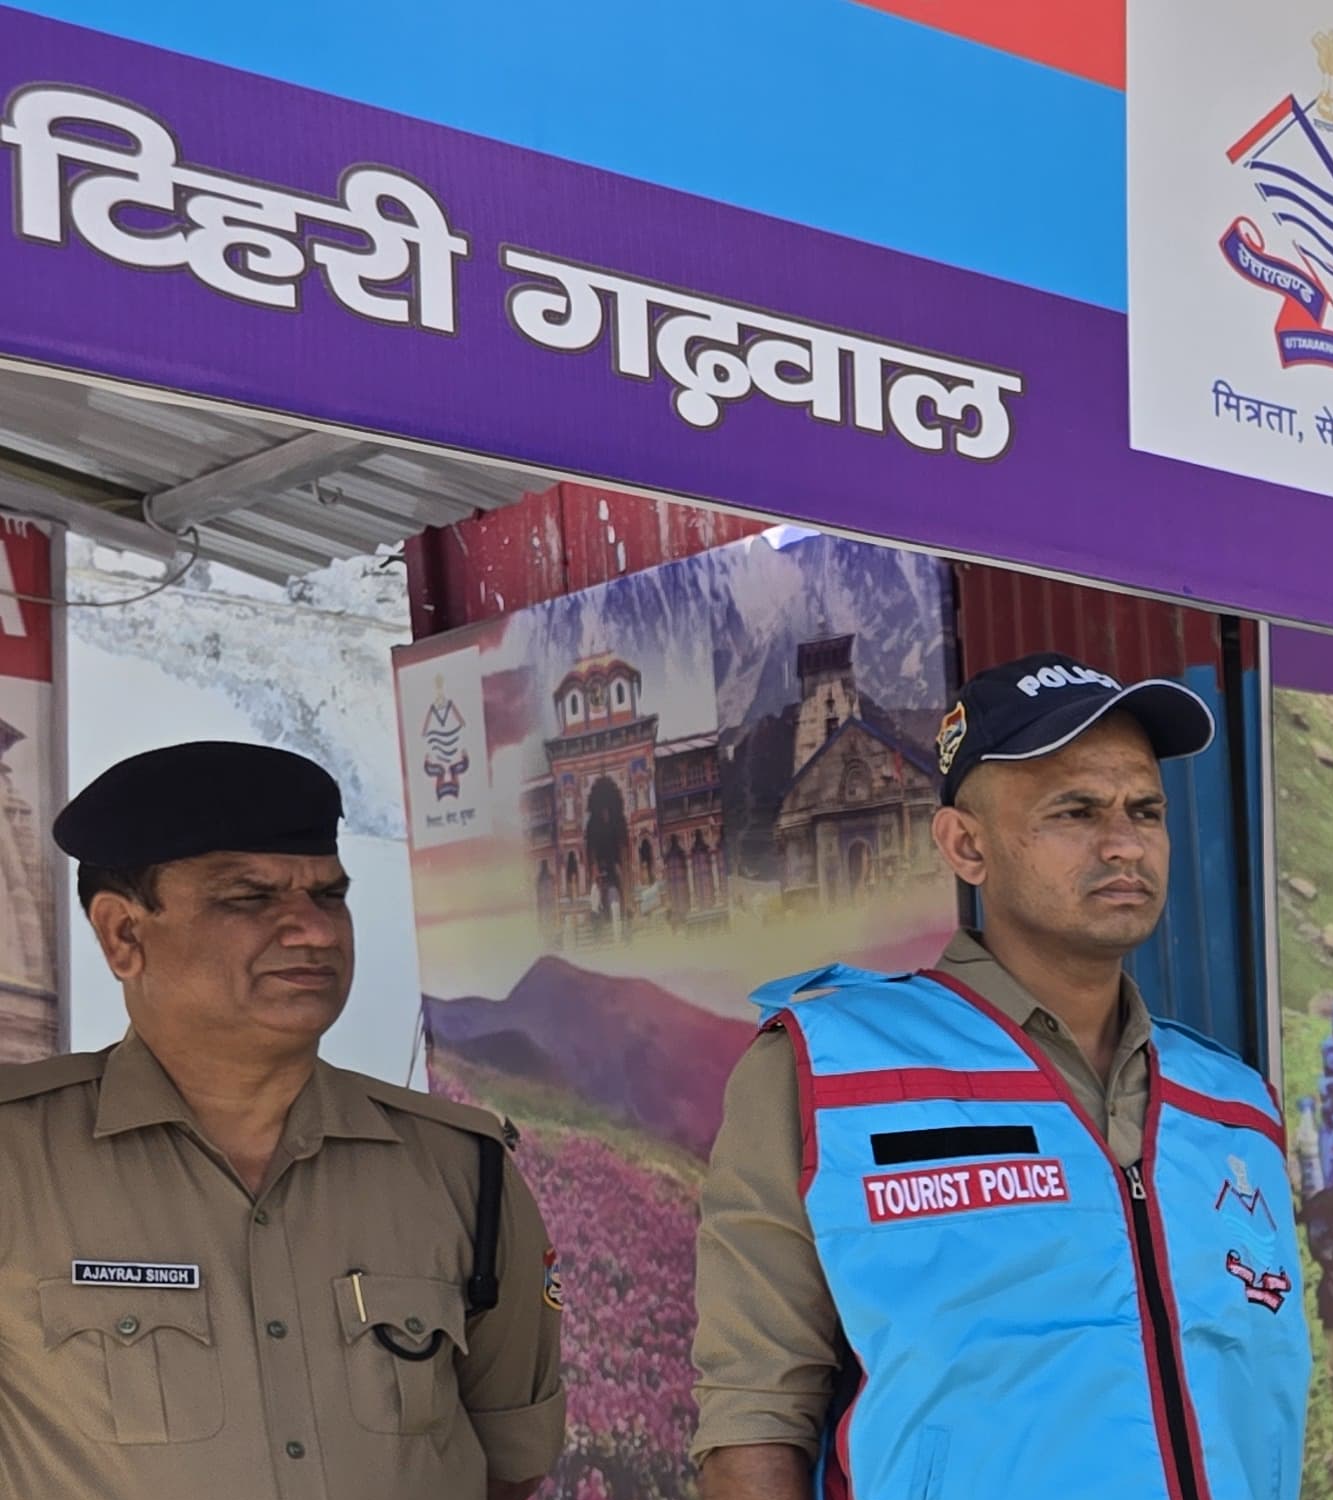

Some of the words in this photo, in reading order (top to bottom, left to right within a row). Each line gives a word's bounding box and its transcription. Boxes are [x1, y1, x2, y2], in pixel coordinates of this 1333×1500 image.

[2, 88, 468, 334] टिहरी
[505, 247, 1022, 460] गढ़वाल
[1212, 381, 1304, 442] मित्रता,
[867, 1172, 970, 1215] TOURIST
[980, 1165, 1064, 1203] POLICE
[83, 1266, 141, 1281] AJAYRAJ
[146, 1269, 188, 1282] SINGH
